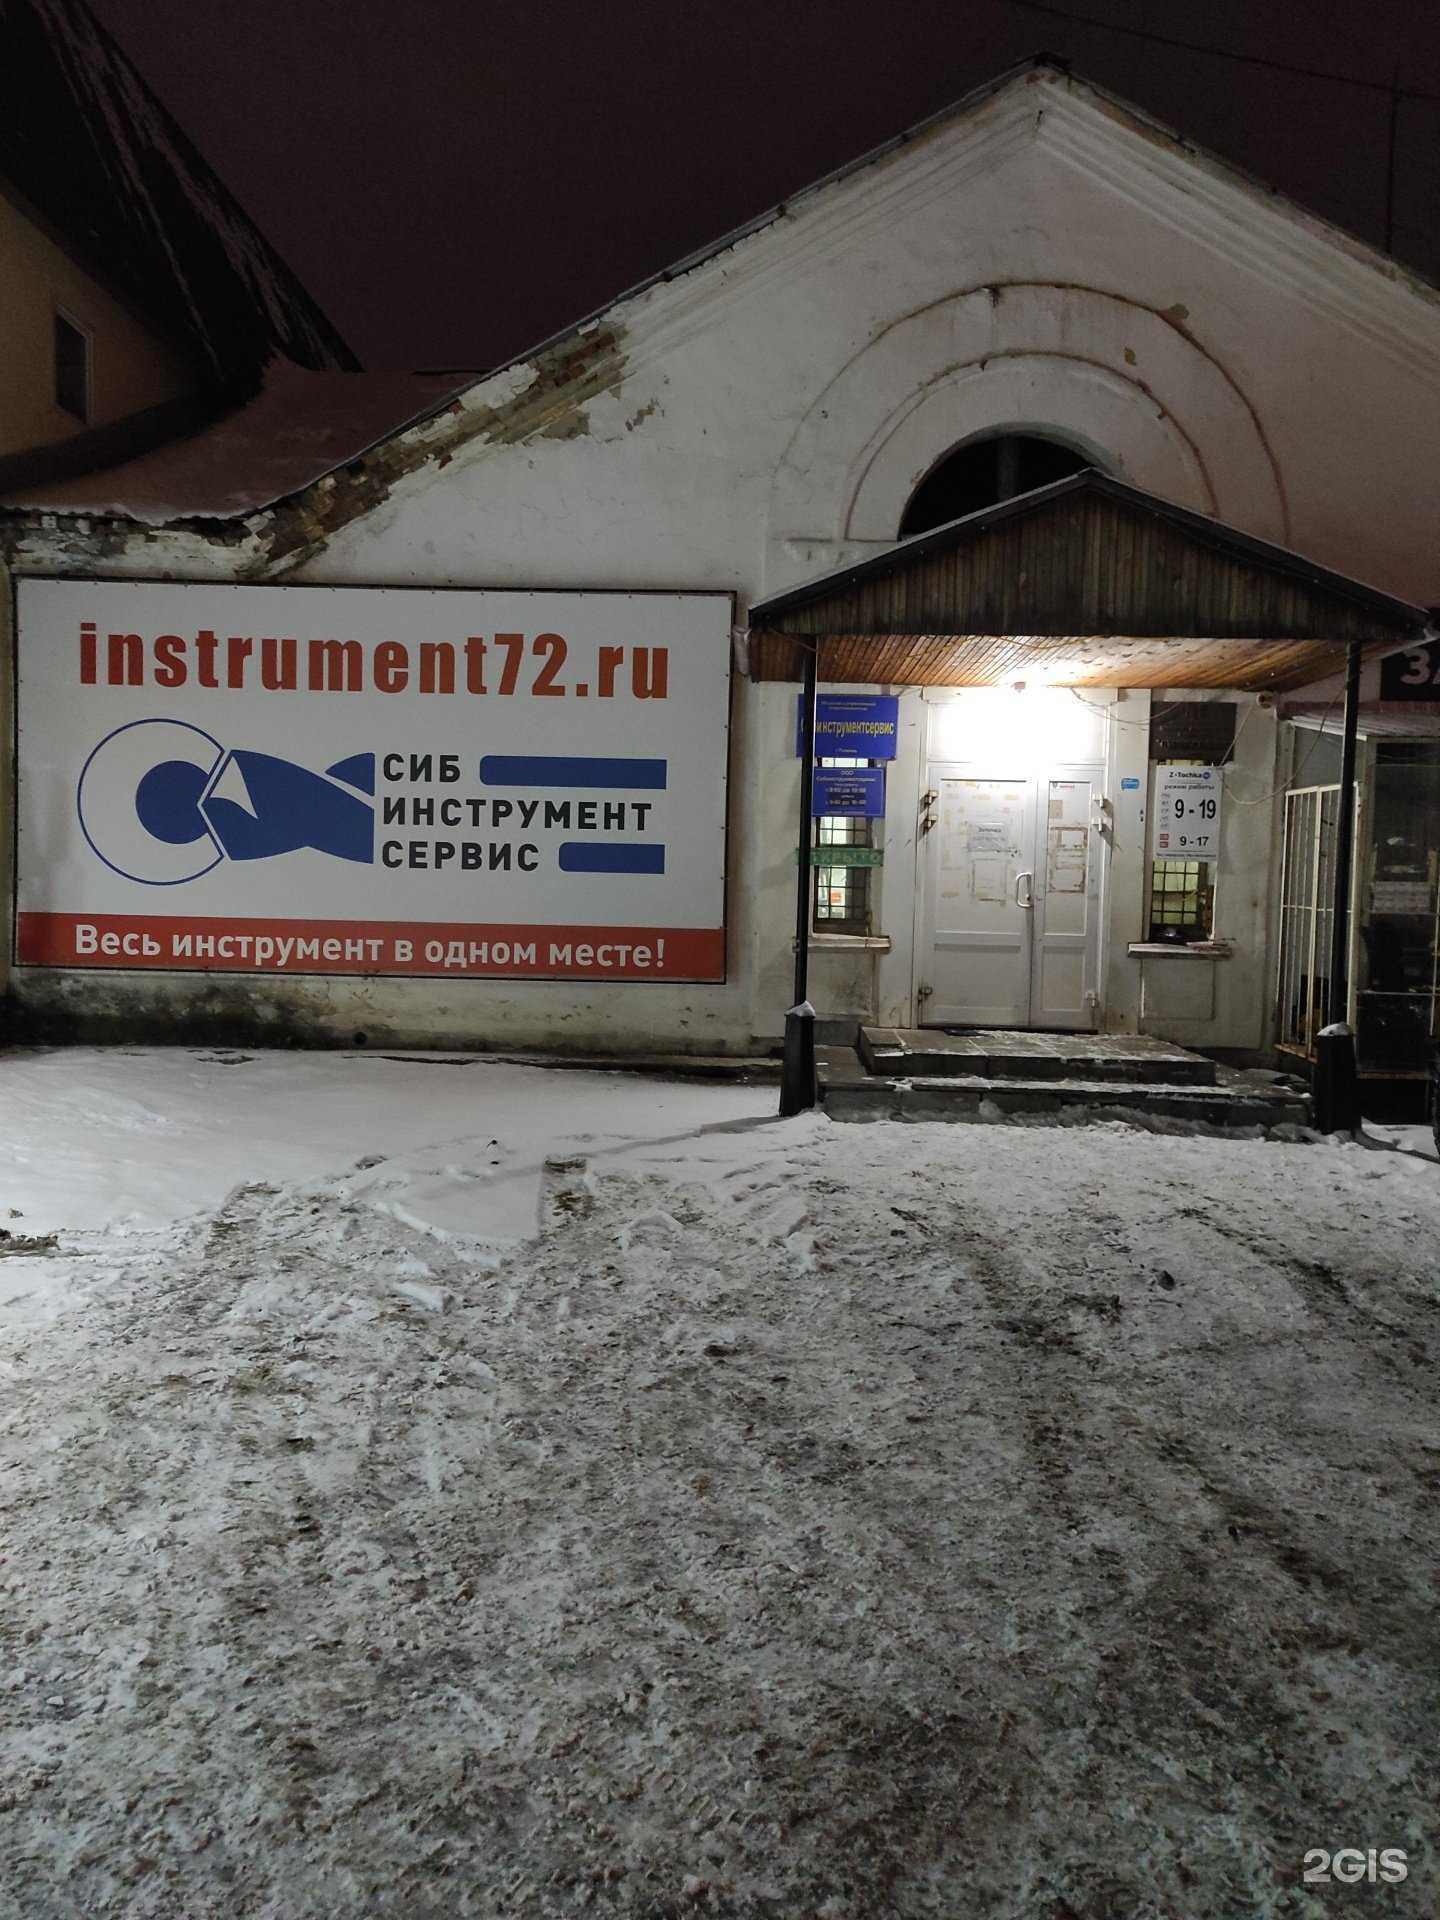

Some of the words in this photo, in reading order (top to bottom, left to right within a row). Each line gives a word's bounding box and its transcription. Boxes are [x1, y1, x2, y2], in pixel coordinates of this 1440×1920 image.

[80, 622, 669, 699] instrument72.ru
[801, 716, 895, 737] инструментсервис
[383, 753, 461, 783] СИБ
[383, 797, 652, 831] ИНСТРУМЕНТ
[1174, 798, 1185, 819] 9
[1198, 798, 1216, 819] 19
[382, 840, 539, 872] СЕРВИС
[1179, 836, 1187, 846] 9
[1197, 836, 1209, 846] 17
[75, 924, 161, 956] Весь
[172, 934, 384, 966] инструмент
[394, 940, 413, 961] в
[424, 940, 536, 968] одном
[549, 939, 664, 968] месте!
